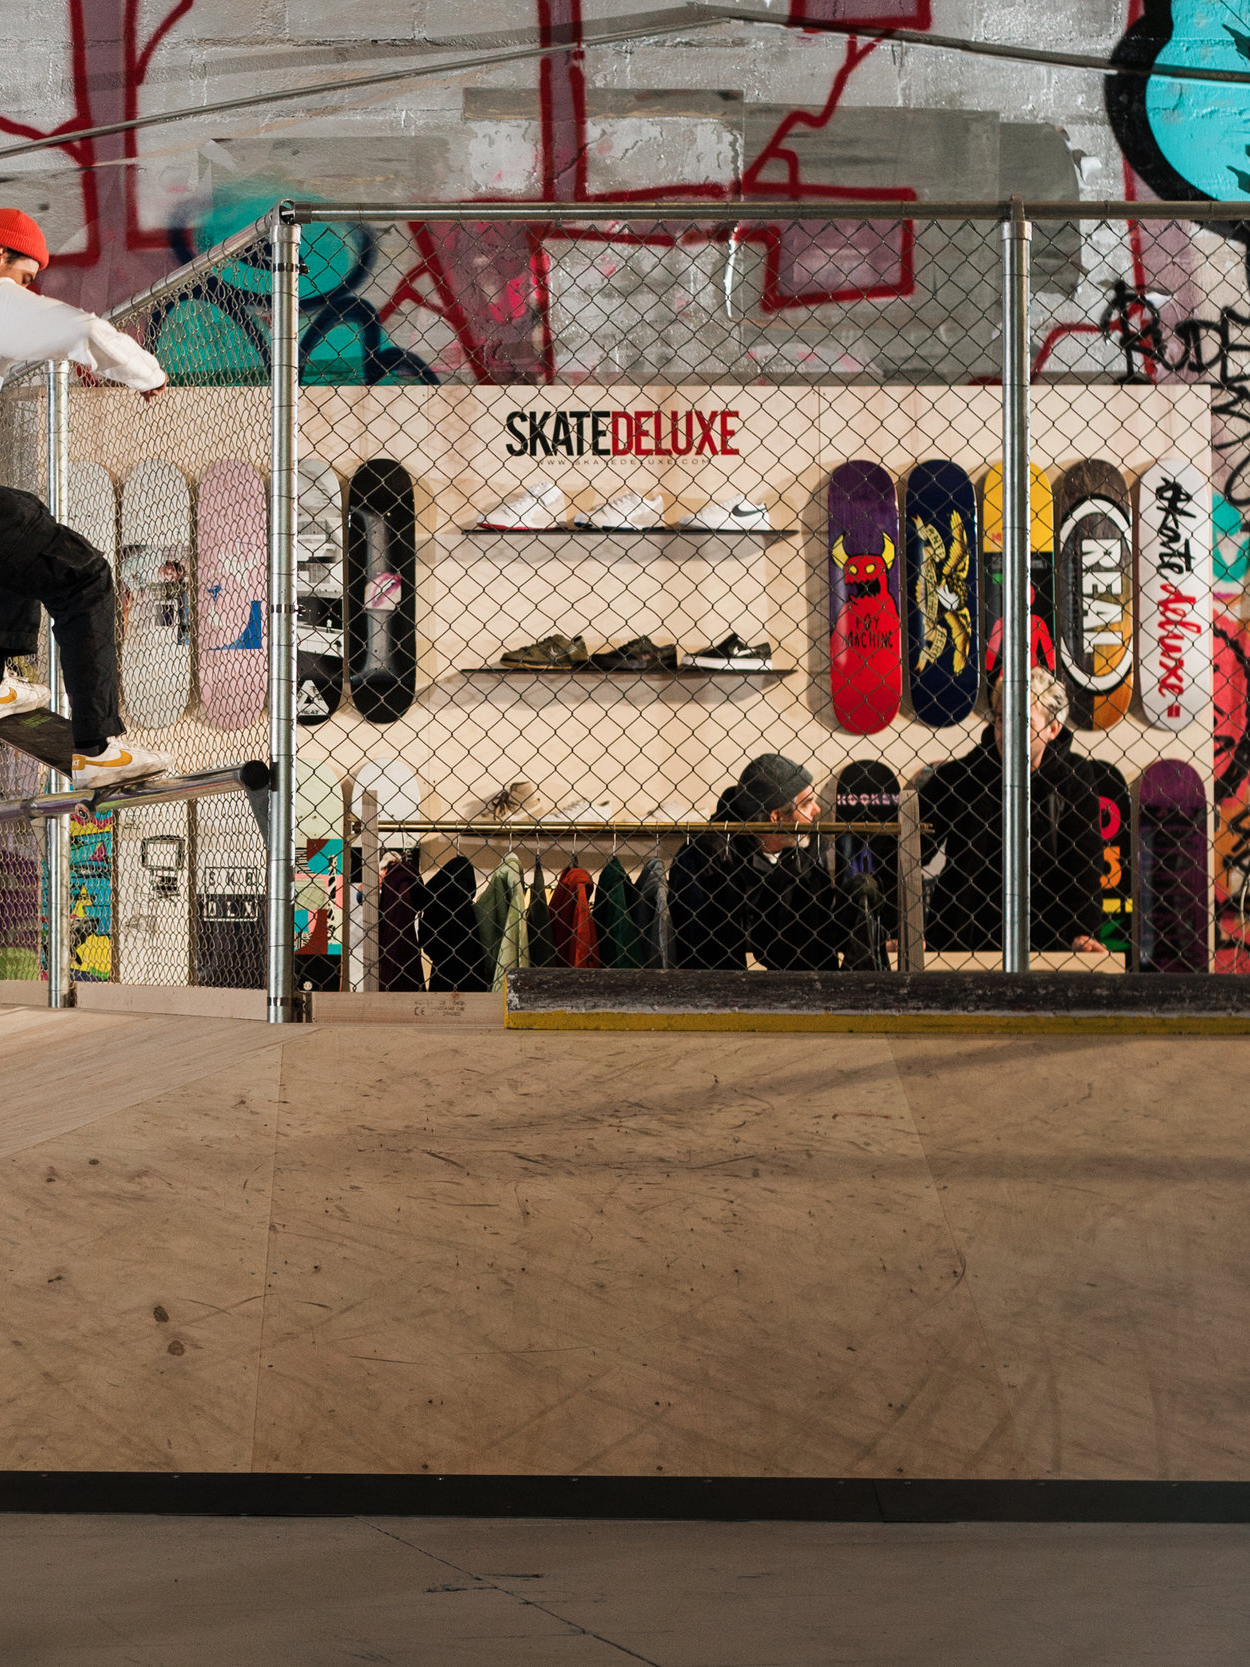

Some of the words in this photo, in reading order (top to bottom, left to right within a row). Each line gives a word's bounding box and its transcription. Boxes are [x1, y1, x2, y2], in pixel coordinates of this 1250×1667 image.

[506, 410, 739, 457] SKATEDELUXE
[1081, 538, 1124, 654] REAL
[208, 901, 255, 917] DLX
